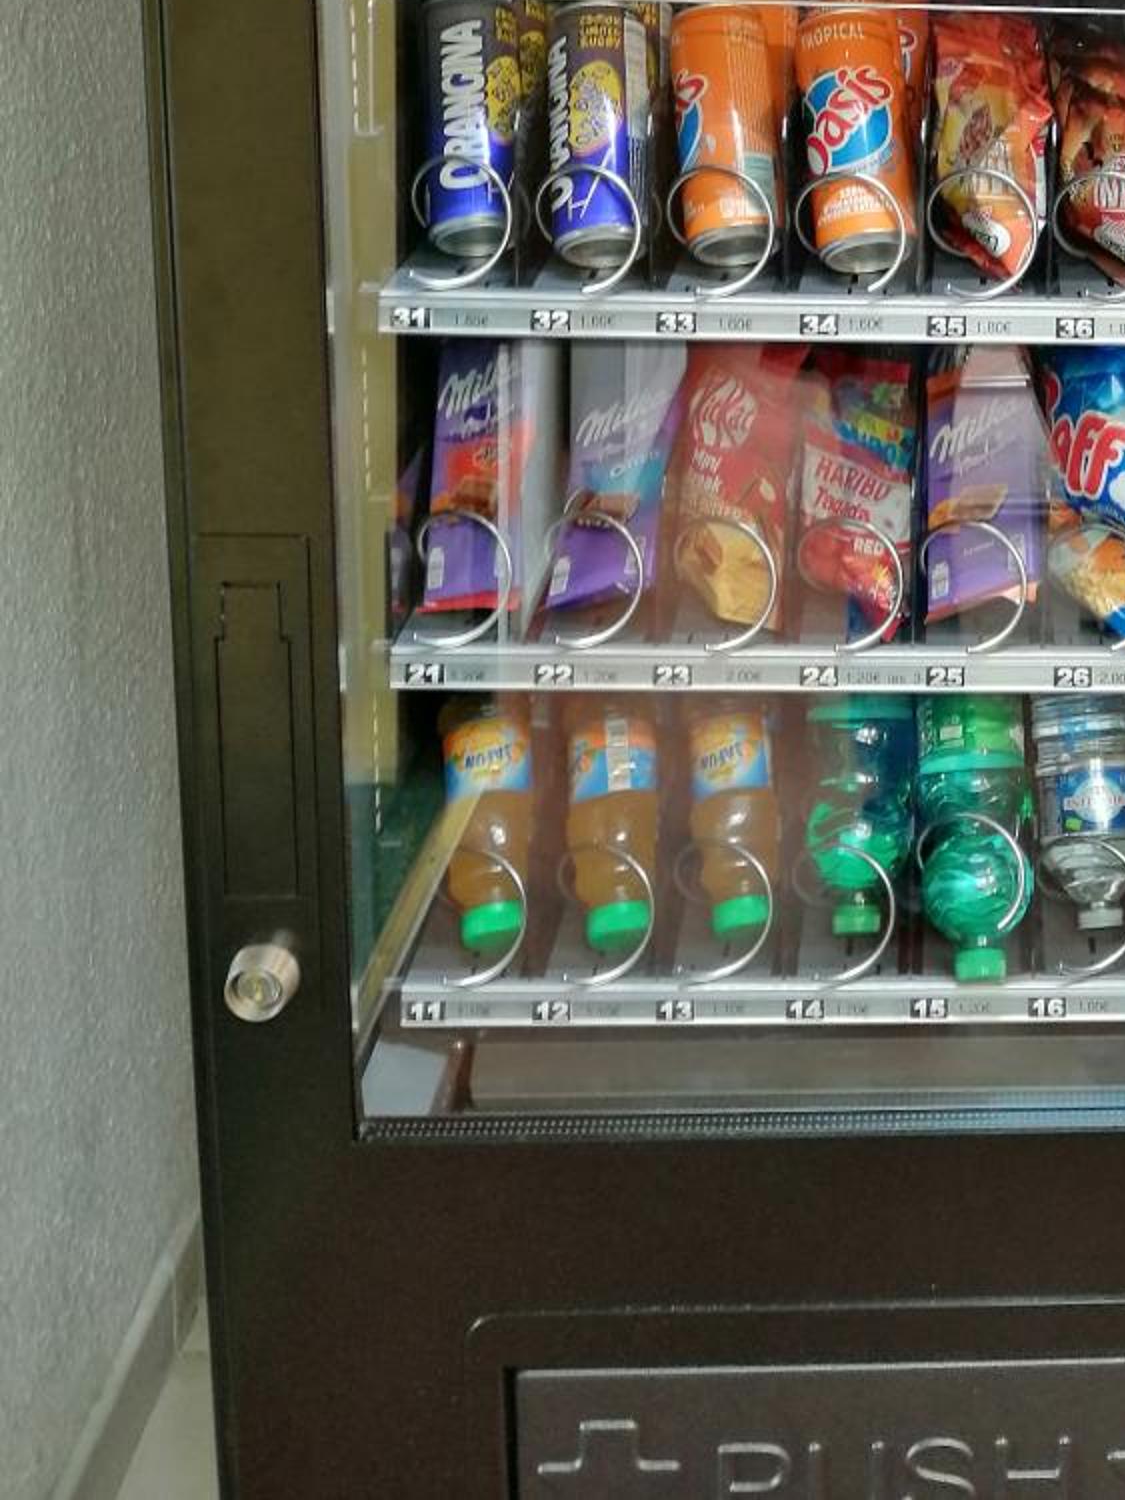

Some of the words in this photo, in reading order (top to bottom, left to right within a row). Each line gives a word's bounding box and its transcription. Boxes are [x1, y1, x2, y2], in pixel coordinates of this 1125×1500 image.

[439, 19, 488, 190] ORANGINA
[391, 306, 427, 329] 31
[533, 309, 570, 332] 32
[659, 313, 695, 334] 33
[802, 314, 838, 335] 34
[930, 317, 965, 338] 35
[1059, 318, 1094, 339] 36
[408, 663, 442, 686] 21
[536, 664, 574, 685] 22
[656, 665, 690, 686] 23
[802, 666, 837, 686] 24
[929, 667, 964, 687] 25
[1057, 668, 1090, 687] 26
[409, 1000, 442, 1021] 11
[536, 1000, 570, 1021] 12
[659, 999, 693, 1020] 13
[789, 999, 824, 1019] 14
[913, 998, 947, 1018] 15
[1031, 998, 1065, 1017] 16
